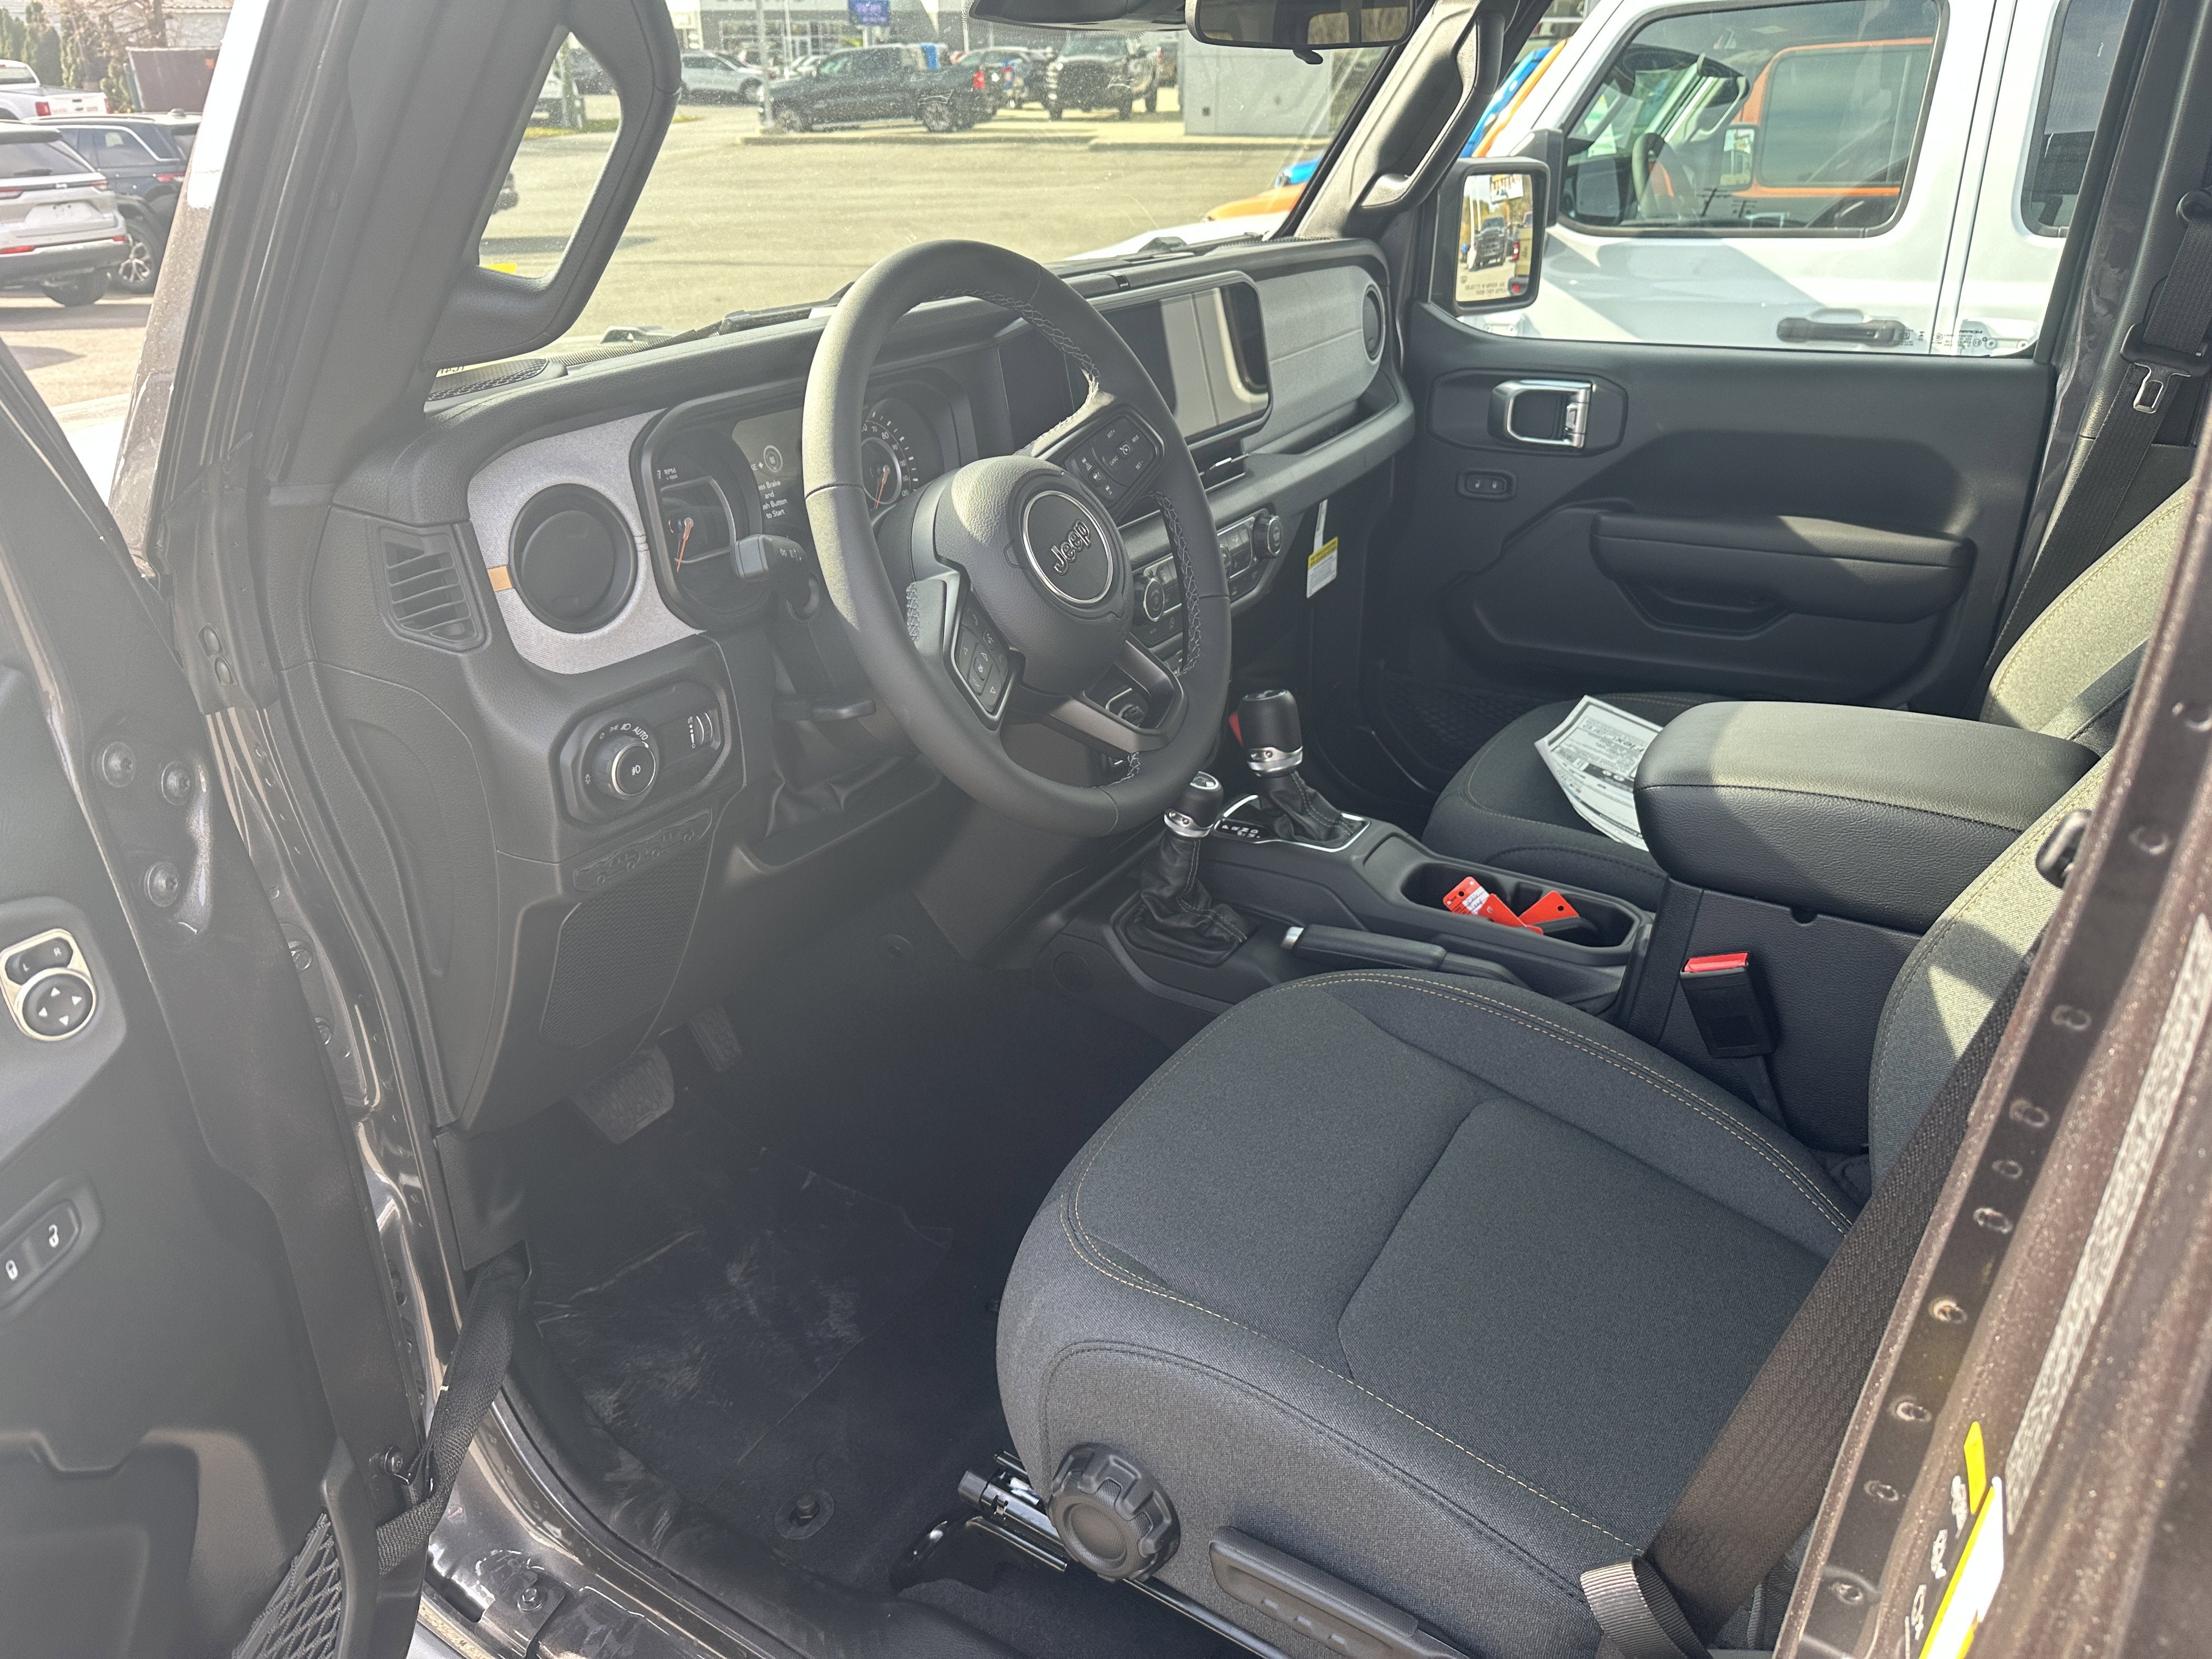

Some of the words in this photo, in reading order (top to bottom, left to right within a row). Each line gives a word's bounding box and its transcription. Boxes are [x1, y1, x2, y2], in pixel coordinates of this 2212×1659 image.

[881, 431, 889, 439] 80
[664, 467, 676, 475] RPM
[766, 479, 781, 489] Brake
[765, 490, 775, 499] and
[770, 499, 788, 508] Button
[772, 509, 786, 517] Start
[1051, 519, 1090, 575] Jeep
[632, 726, 648, 741] AUTO
[53, 947, 62, 956] R
[22, 963, 30, 973] L
